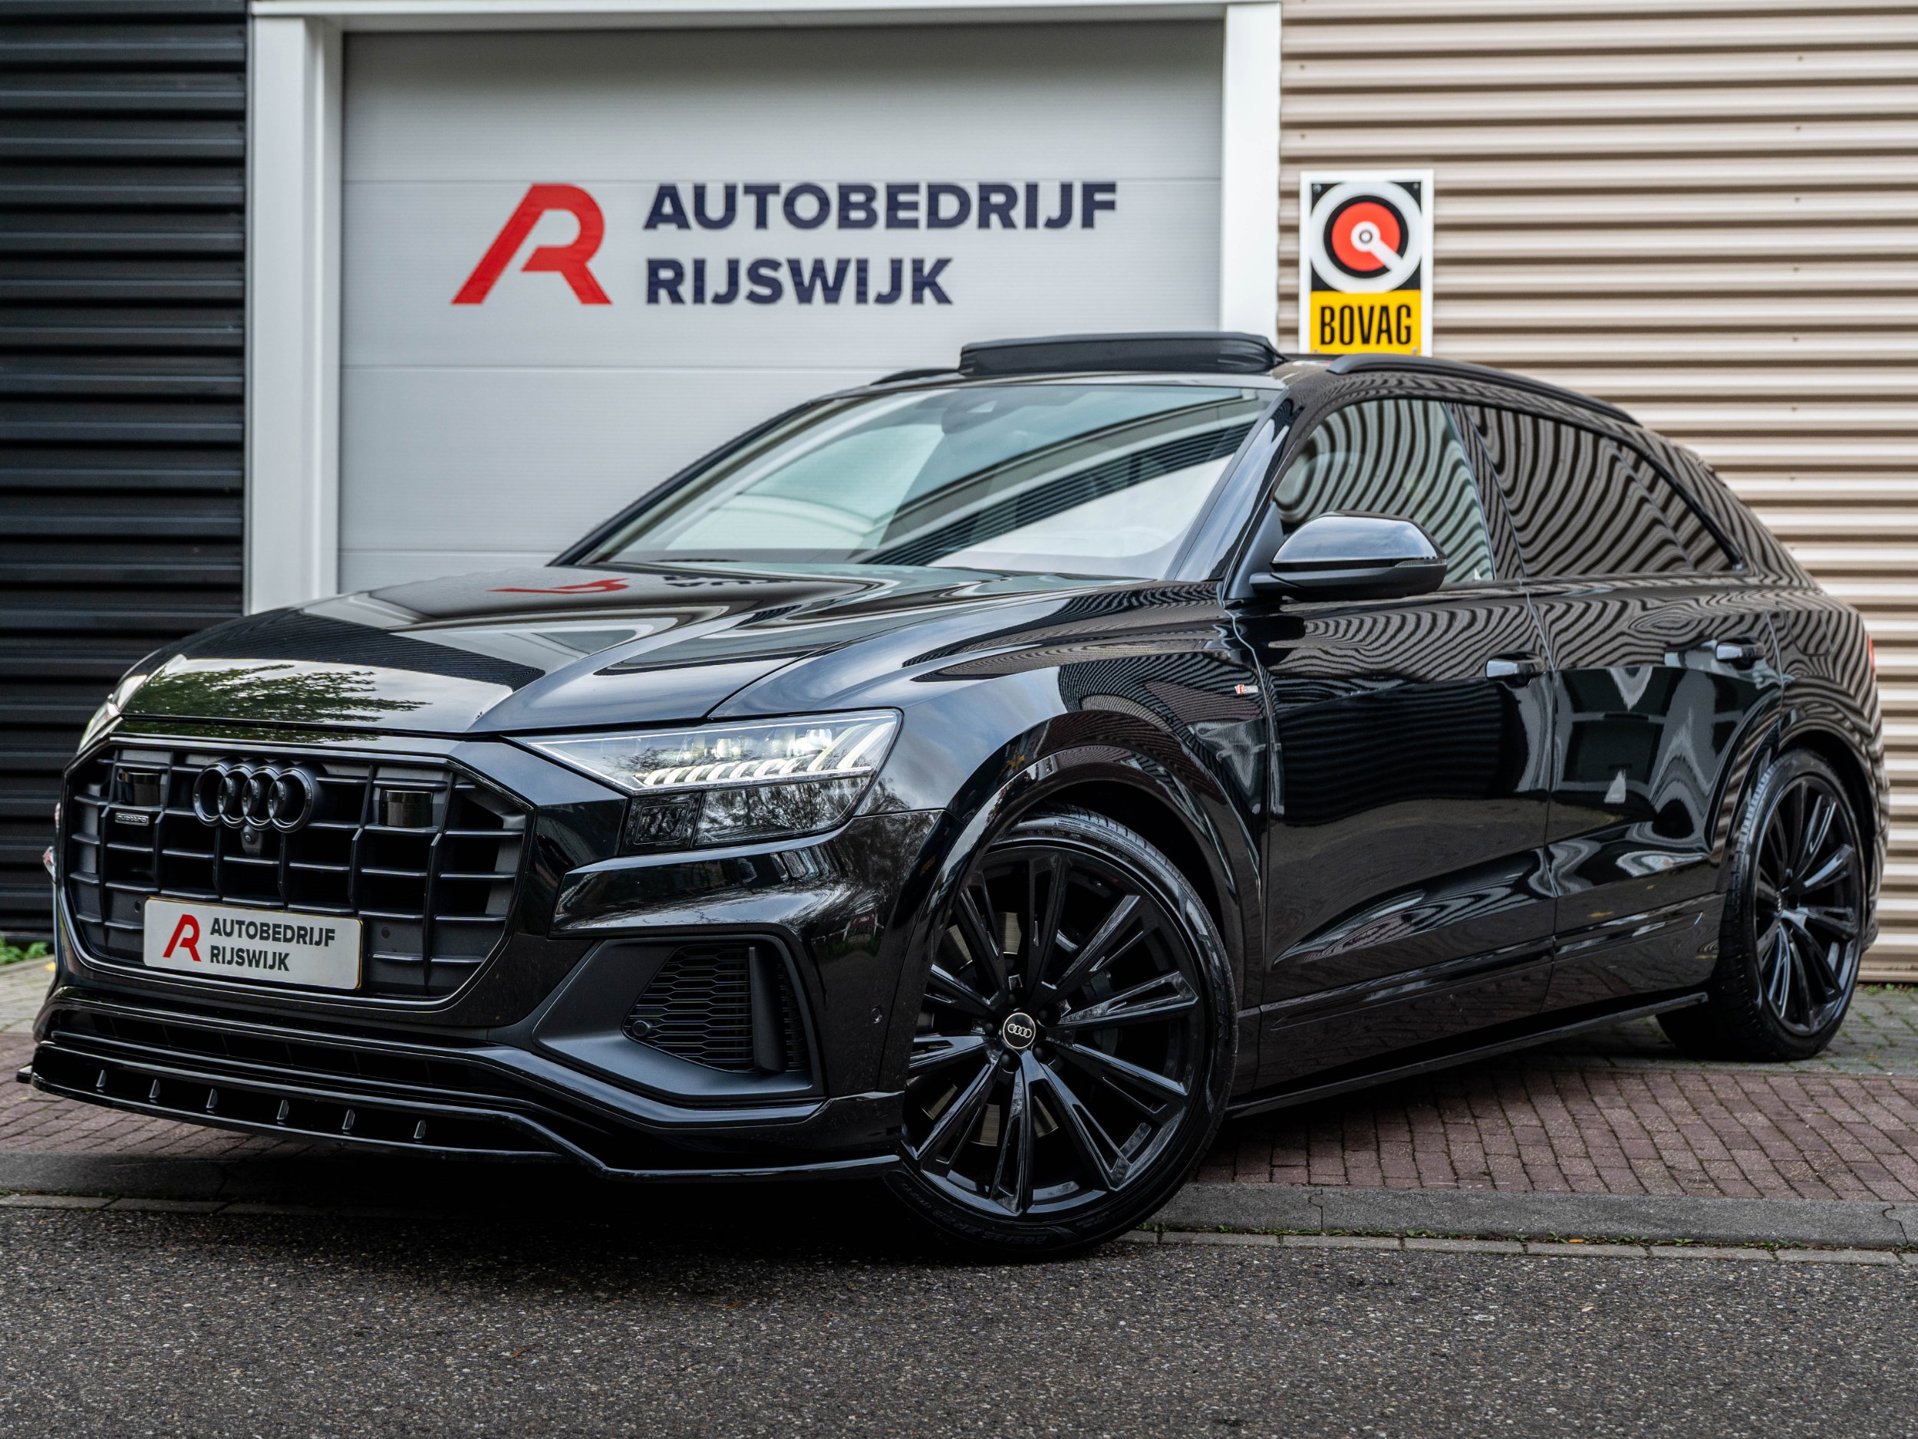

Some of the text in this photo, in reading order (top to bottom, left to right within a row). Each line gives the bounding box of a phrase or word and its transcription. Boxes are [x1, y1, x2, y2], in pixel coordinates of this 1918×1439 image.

[643, 181, 1118, 231] AUTOBEDRIJF
[645, 257, 954, 306] RIJSWIJK
[1319, 304, 1412, 346] BOVAG
[209, 917, 336, 947] AUTOBEDRIJF
[209, 944, 290, 972] RIJSWIJK
